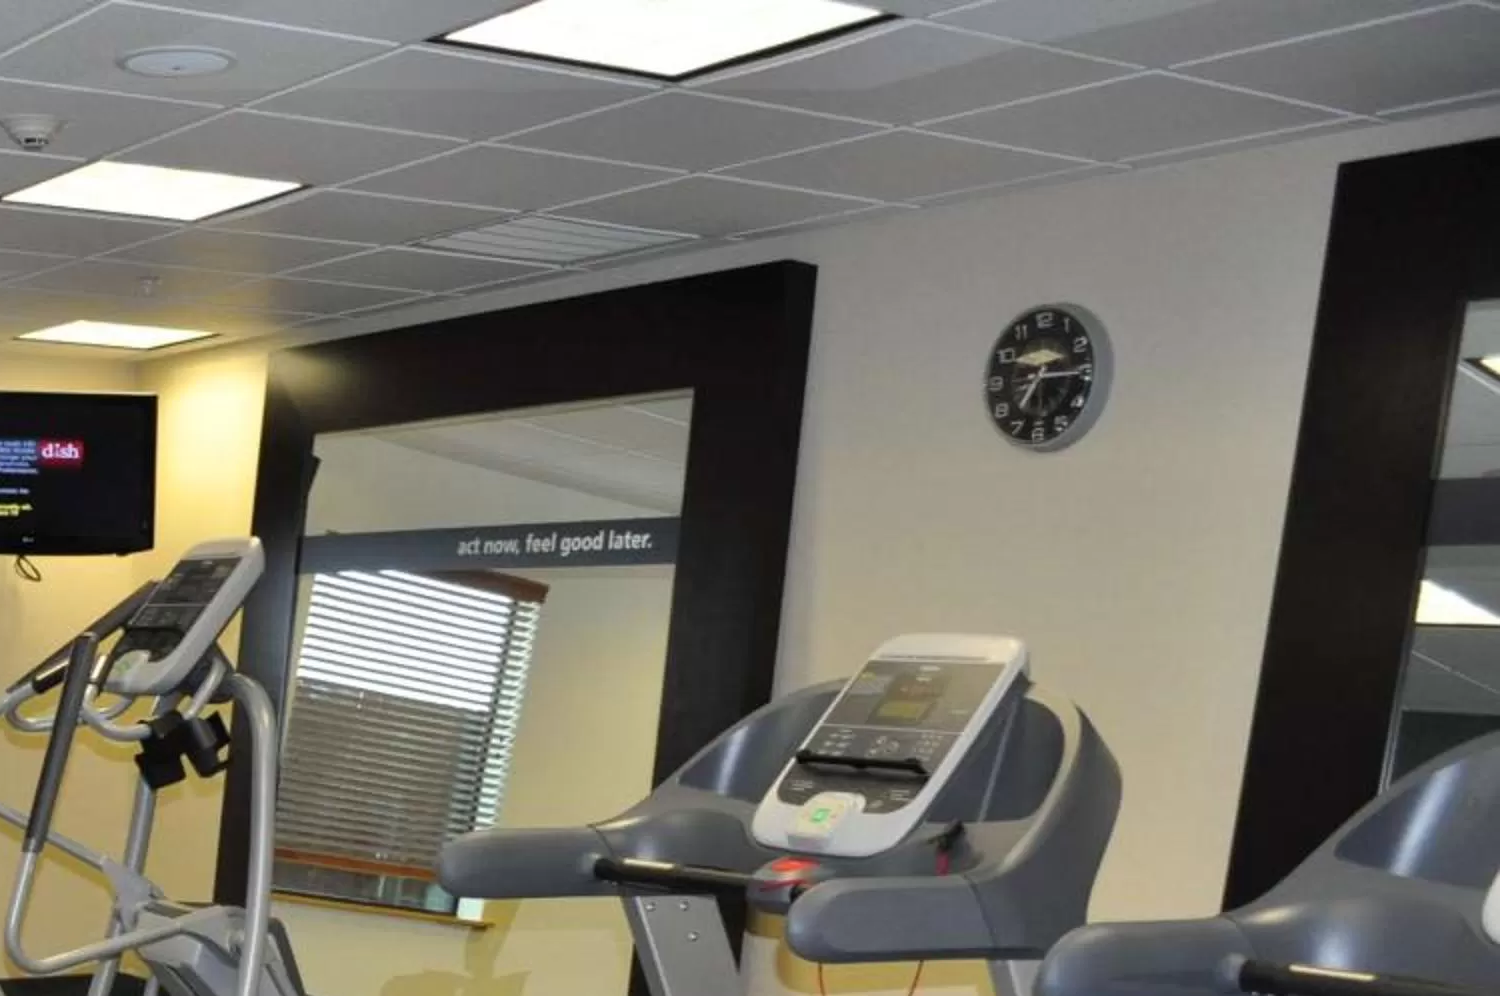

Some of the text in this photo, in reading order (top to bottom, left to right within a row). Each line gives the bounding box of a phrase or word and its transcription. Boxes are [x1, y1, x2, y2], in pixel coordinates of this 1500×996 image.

[1014, 324, 1028, 341] 11
[1073, 335, 1088, 353] 2
[995, 402, 1009, 418] 8
[1010, 420, 1025, 436] 7
[41, 442, 80, 460] dish
[456, 529, 653, 558] act now, feel good later.
